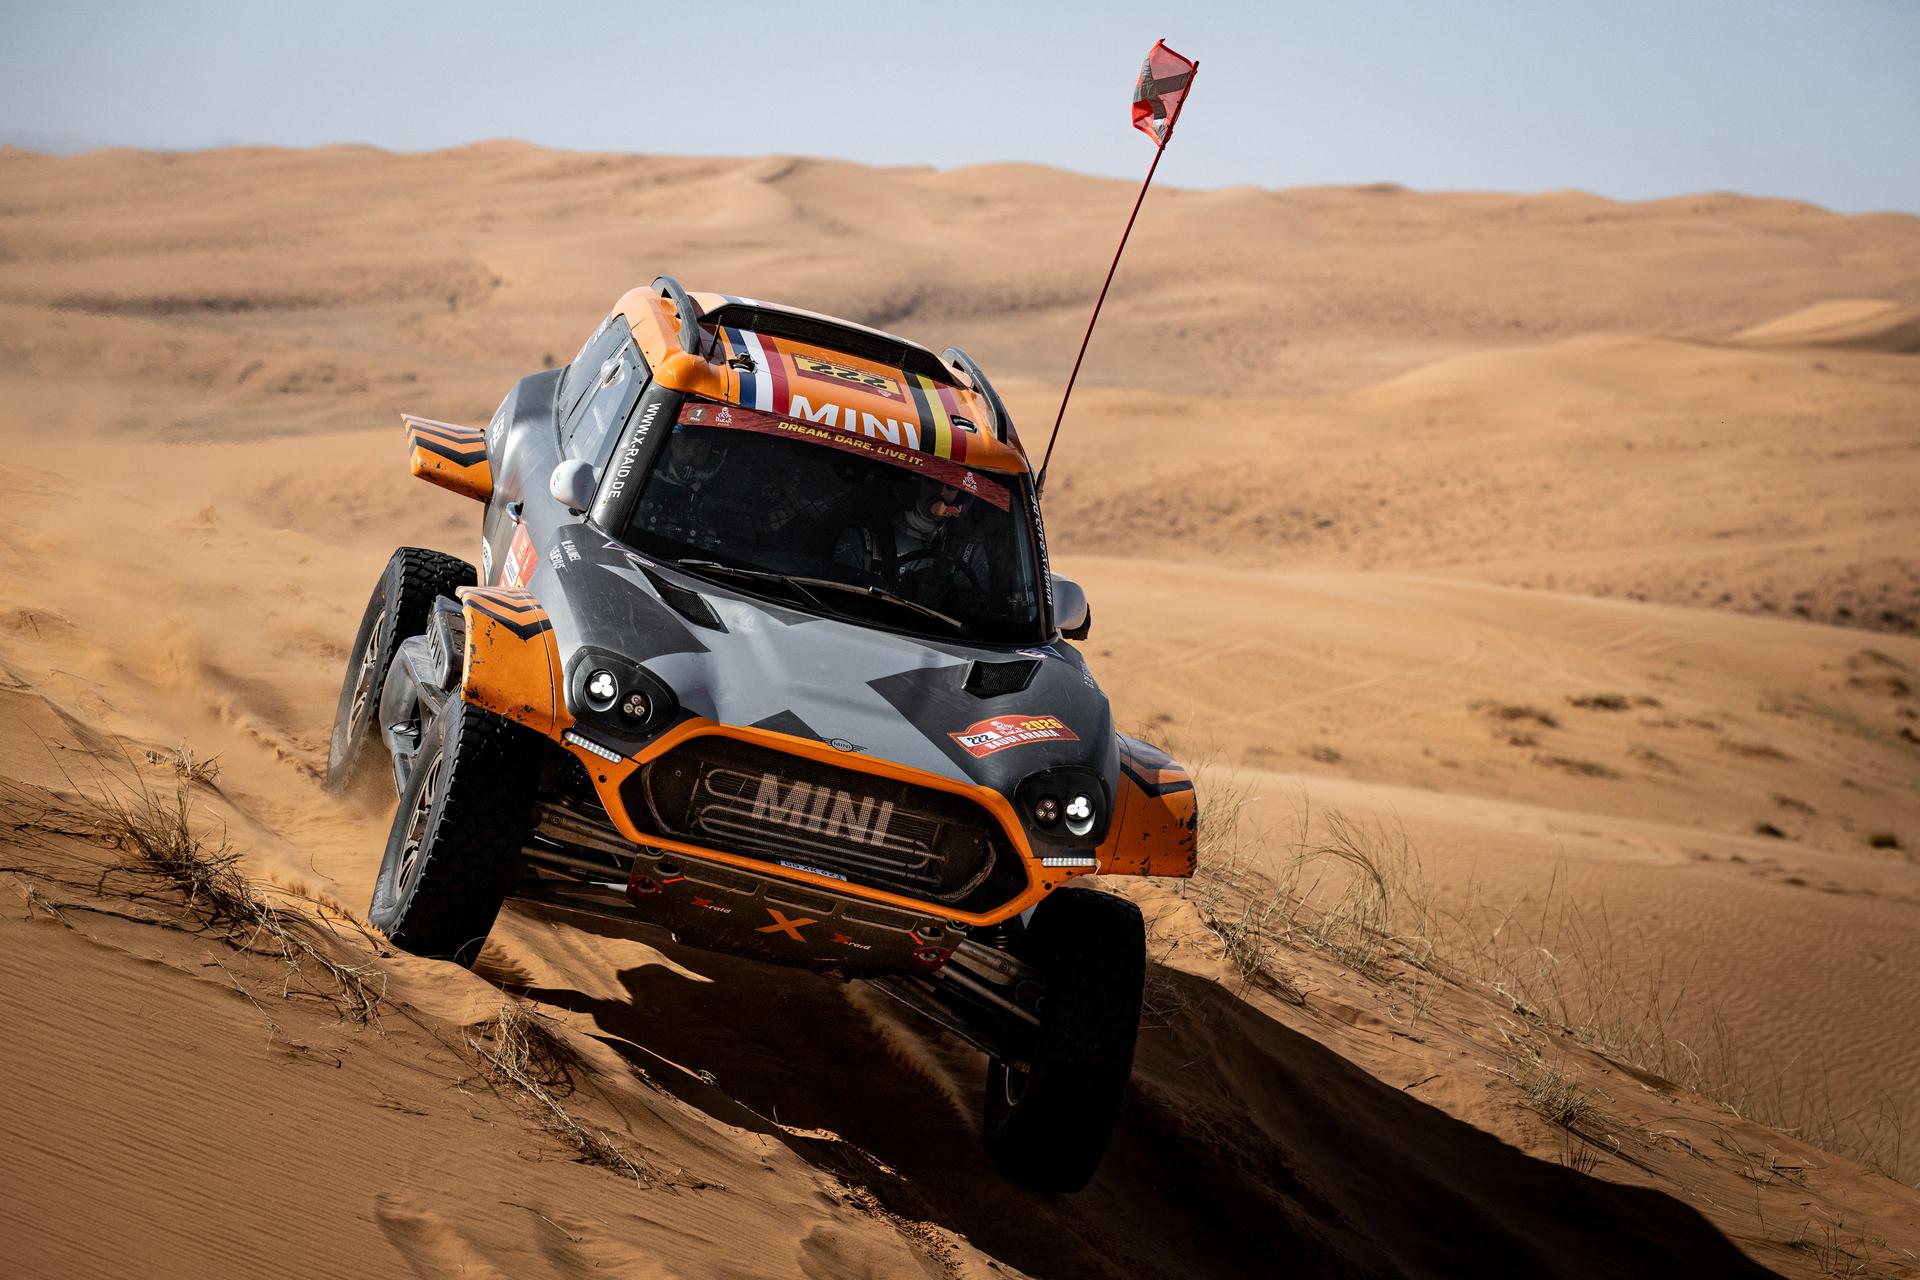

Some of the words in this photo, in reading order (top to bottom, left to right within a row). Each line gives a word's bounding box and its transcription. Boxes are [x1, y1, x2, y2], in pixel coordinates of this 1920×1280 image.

[807, 360, 888, 389] 222
[788, 394, 920, 451] MINI
[608, 403, 662, 498] WWW.X-RAID.DE
[777, 421, 831, 440] DREAM.
[834, 434, 874, 451] DARE.
[877, 446, 906, 460] LIVE
[908, 456, 924, 467] IT.
[966, 734, 994, 745] 222
[984, 735, 1020, 749] SAUDI
[1019, 729, 1060, 741] ARABIA
[1020, 719, 1063, 731] 2026
[833, 741, 851, 749] MINI
[751, 773, 895, 846] MINI
